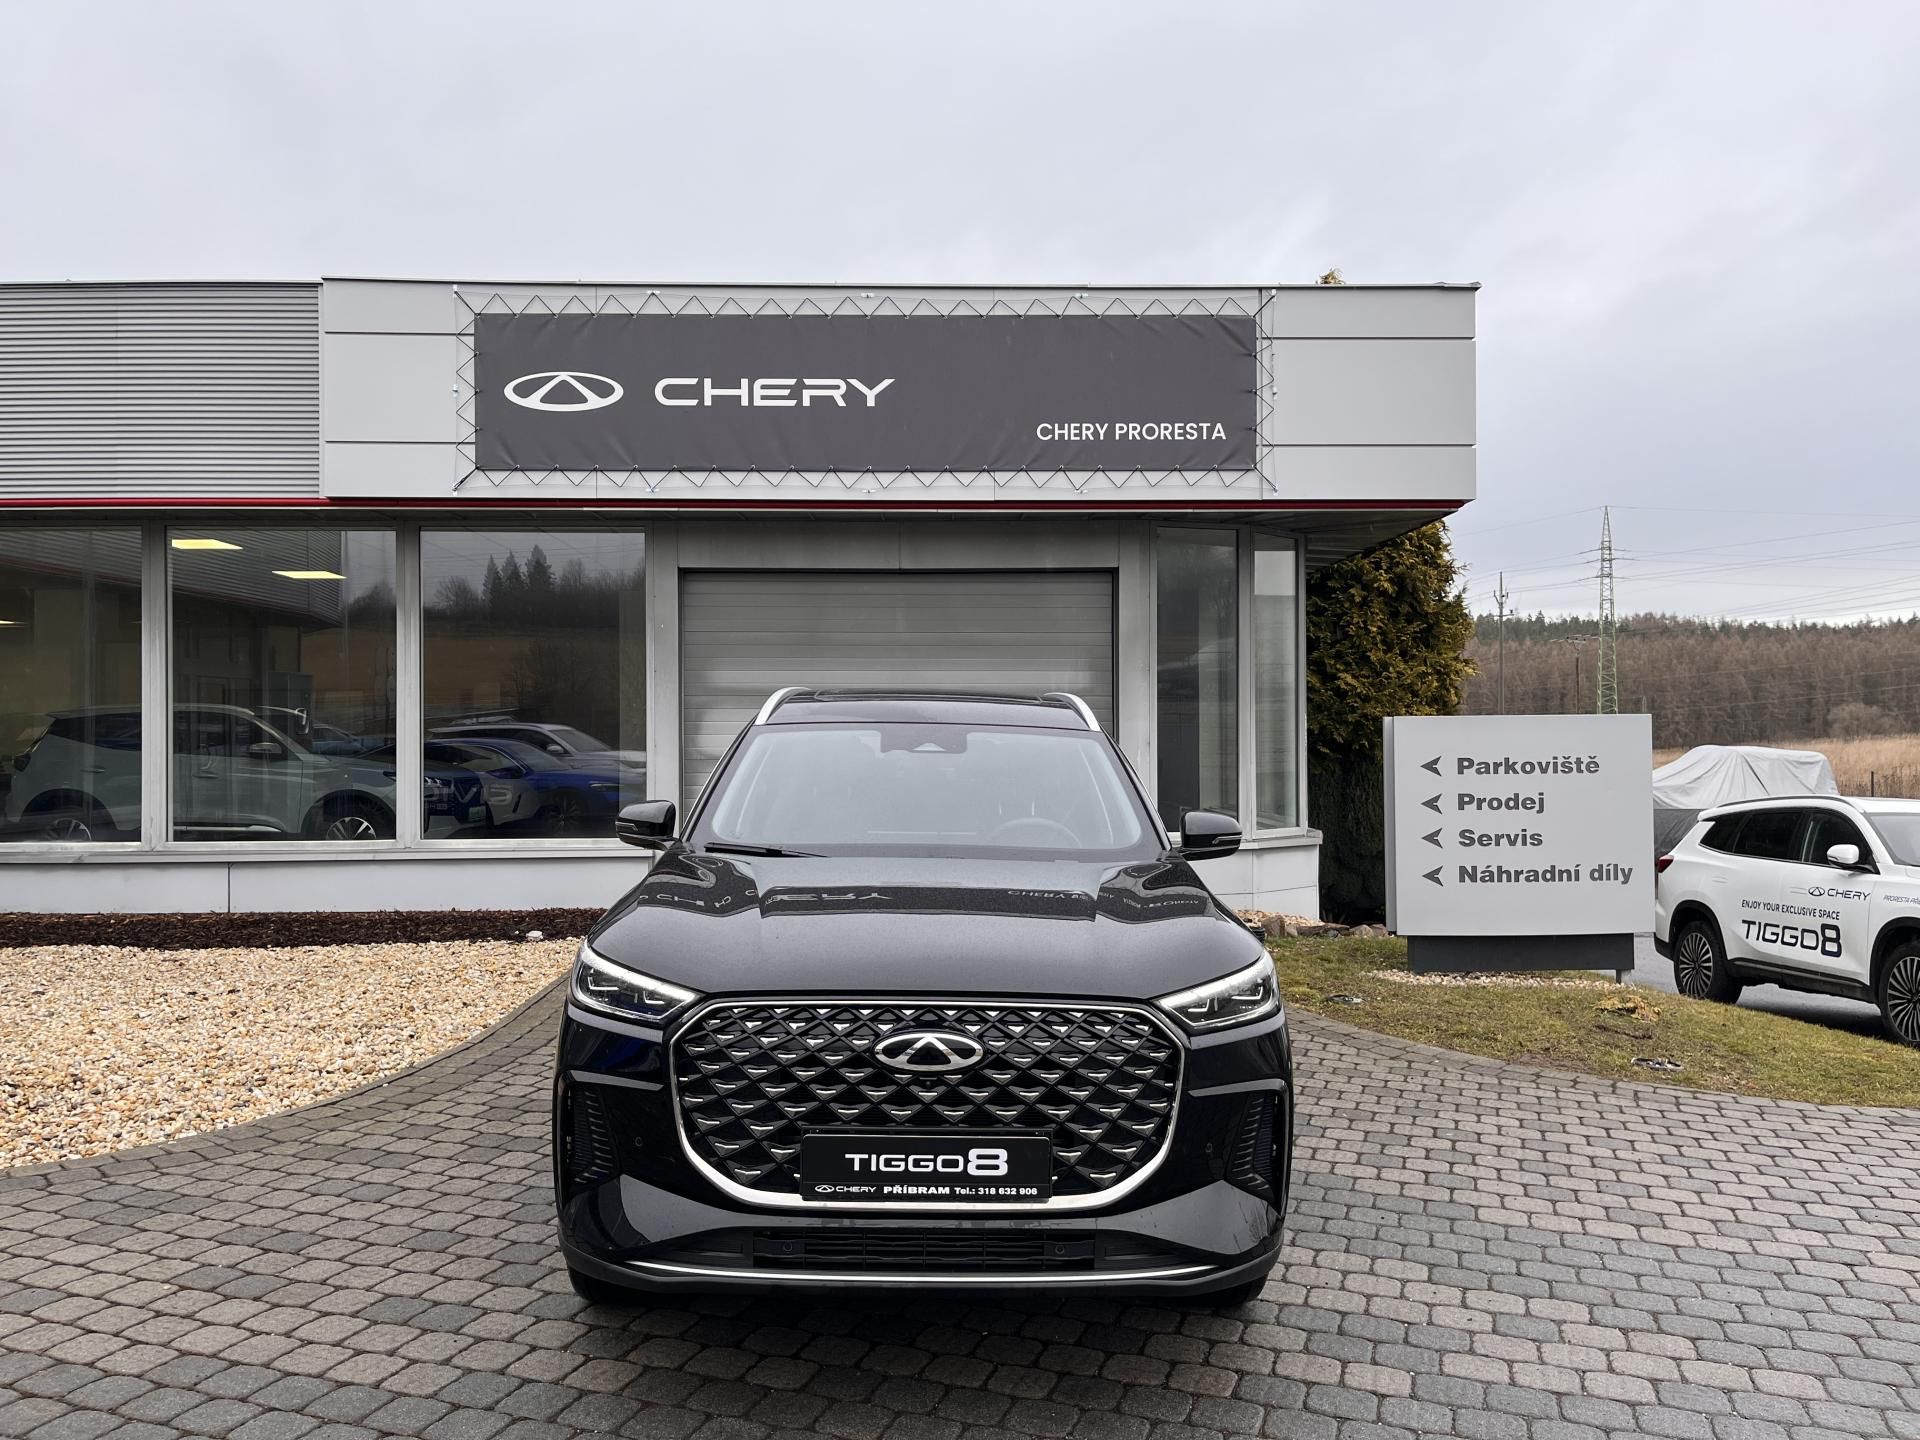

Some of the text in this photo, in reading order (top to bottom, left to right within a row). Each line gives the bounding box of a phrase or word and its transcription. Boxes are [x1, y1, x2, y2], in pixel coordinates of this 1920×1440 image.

[654, 377, 896, 407] CHERY
[1036, 422, 1227, 441] CHERY PRORESTA
[1456, 755, 1600, 776] Parkoviště
[1457, 792, 1545, 815] Prodej
[1458, 828, 1544, 848] Servis
[1458, 863, 1633, 886] Náhradní díly
[1827, 888, 1872, 901] CHERY
[1741, 899, 1840, 921] ENJOY YOUR EXCLUSIVE SPACE
[835, 1183, 1038, 1196] CHERY PŘÍBRAM Tel.: 318 632 906
